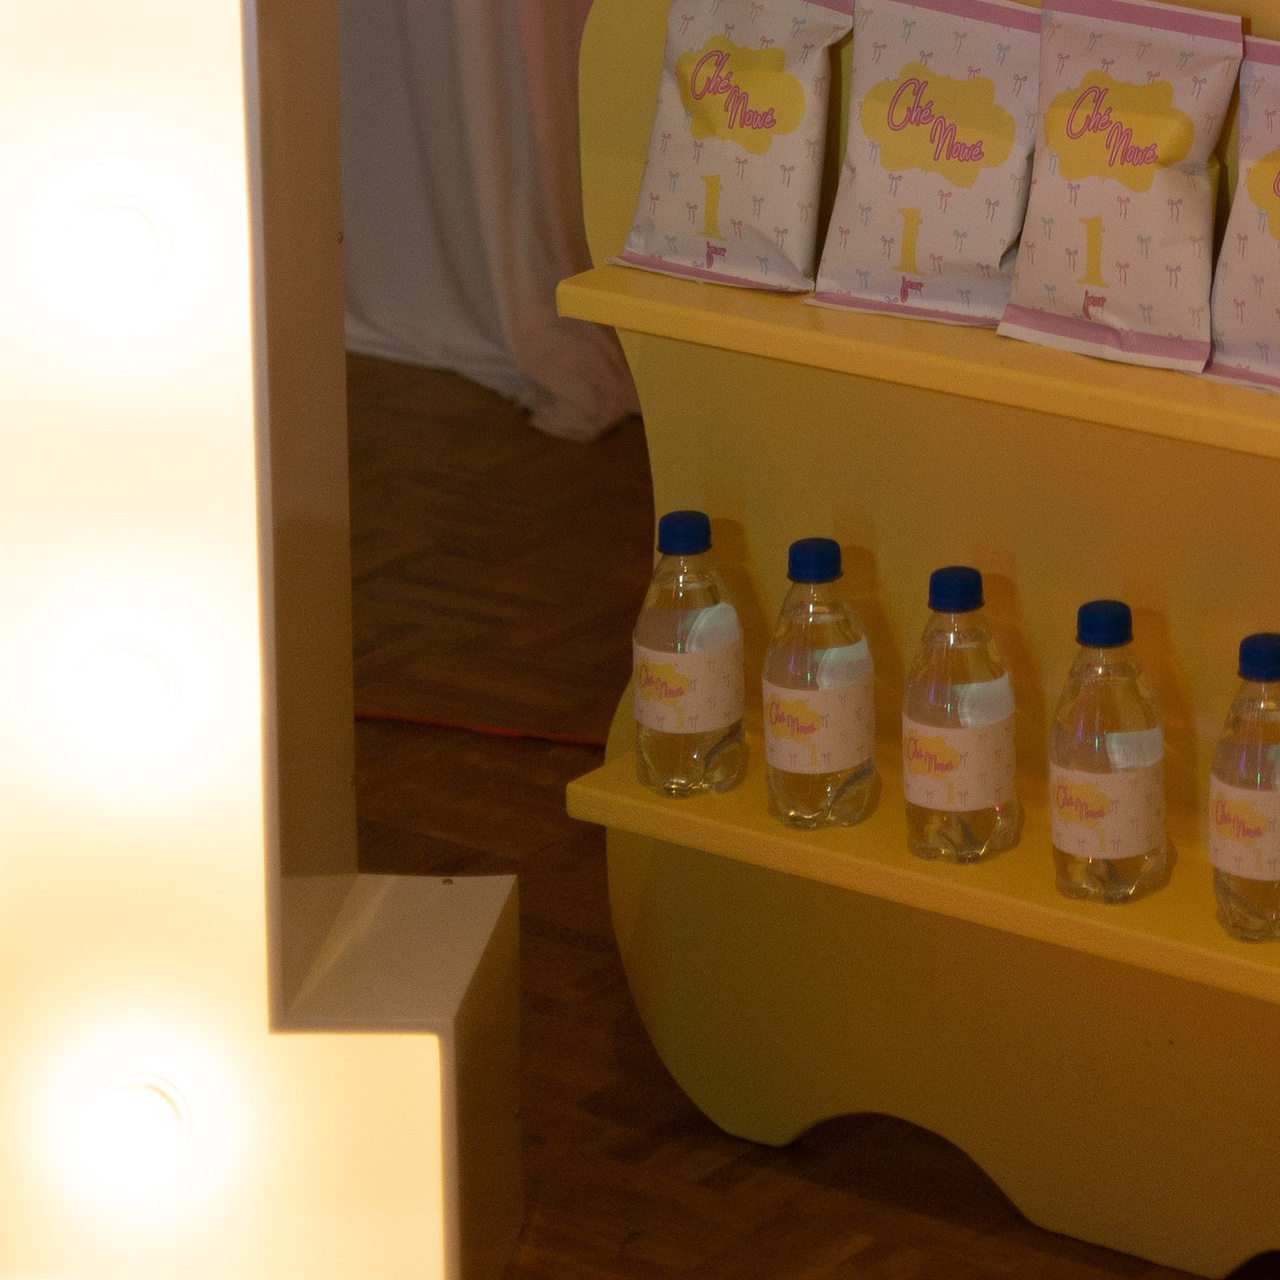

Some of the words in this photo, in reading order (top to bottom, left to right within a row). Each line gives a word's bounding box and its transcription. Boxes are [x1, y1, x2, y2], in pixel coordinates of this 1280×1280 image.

[691, 50, 731, 100] Ché
[724, 85, 776, 131] Nowé
[887, 79, 934, 131] Ché
[1066, 86, 1111, 139] Ché
[930, 118, 983, 162] Nowé
[1106, 123, 1158, 168] Nowé
[696, 174, 724, 241] 1
[894, 208, 925, 274] 1
[1077, 215, 1109, 287] 1
